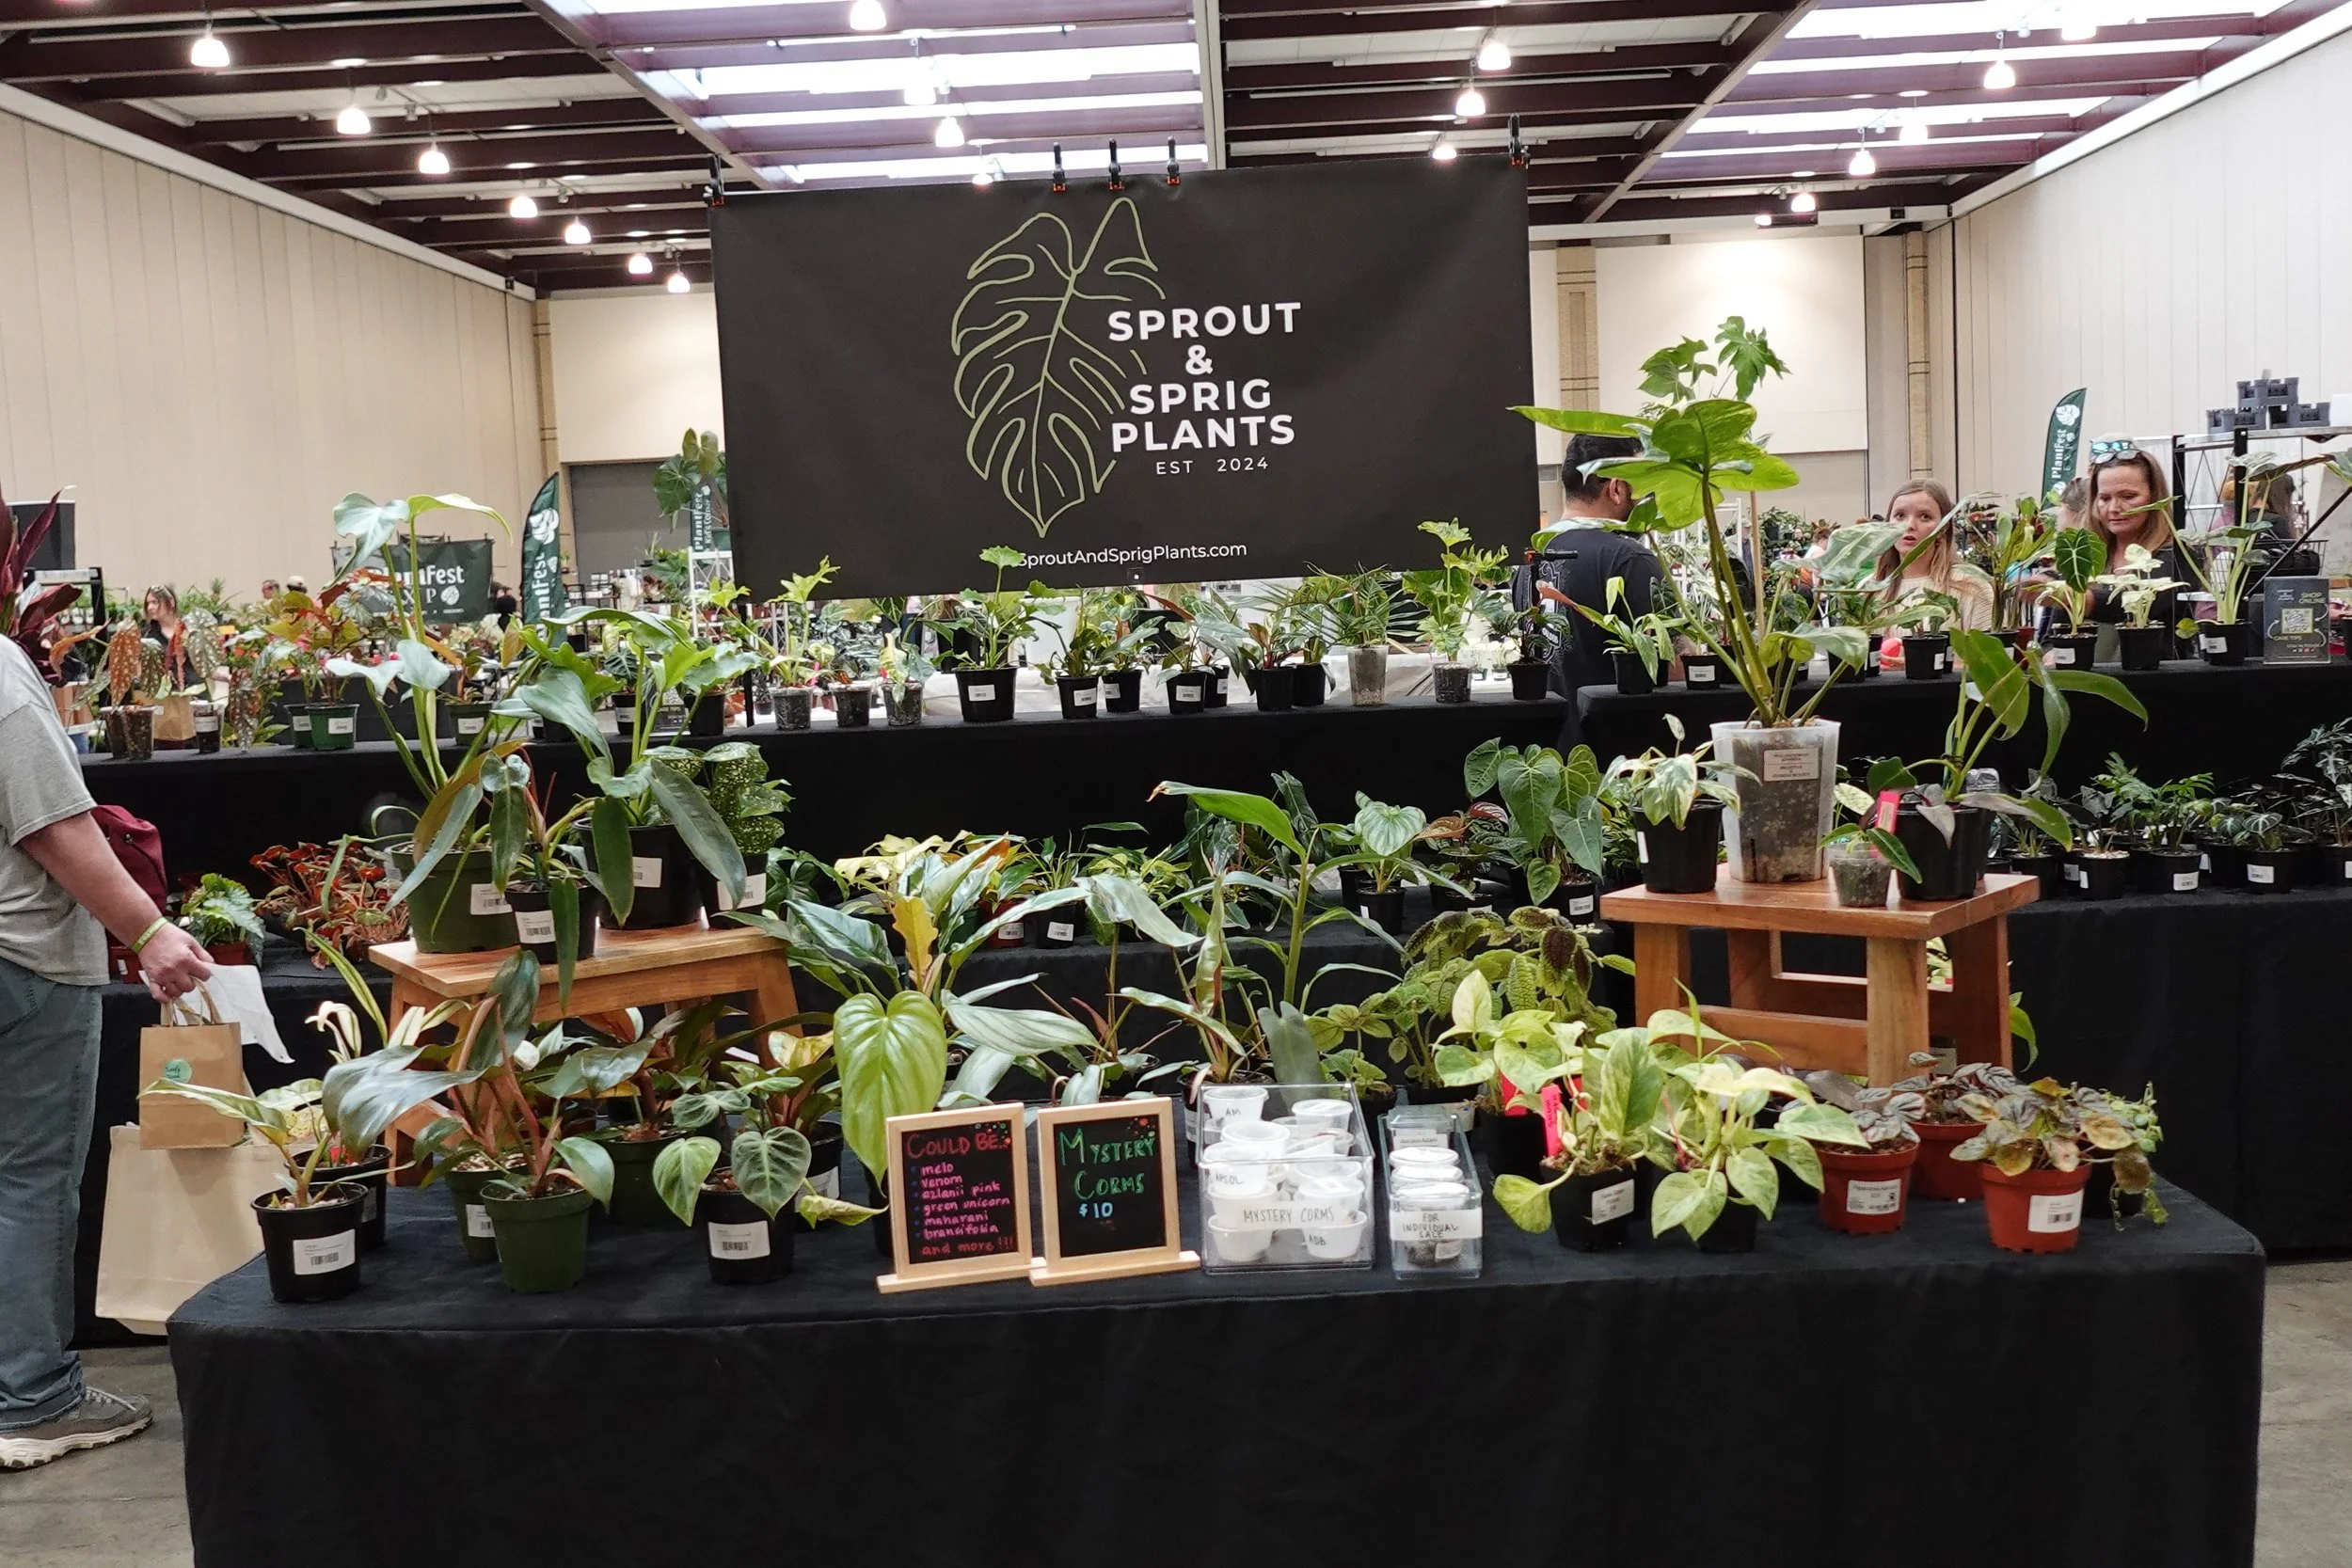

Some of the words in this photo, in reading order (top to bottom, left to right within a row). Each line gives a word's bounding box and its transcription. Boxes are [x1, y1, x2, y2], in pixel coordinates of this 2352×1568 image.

[1107, 302, 1301, 341] SPROUT
[1185, 344, 1214, 375] &
[1130, 378, 1271, 415] SPRIG
[1111, 415, 1295, 452] PLANTS
[1156, 460, 1194, 475] EST
[1216, 457, 1269, 473] 2024
[1019, 544, 1248, 568] SproutAndSprigPlants.com
[907, 1133, 971, 1159] COULD
[921, 1162, 954, 1176] melo
[921, 1175, 962, 1189] venom
[971, 1180, 1001, 1196] pink
[923, 1201, 959, 1216] green
[962, 1196, 1010, 1210] unicorn
[1243, 1209, 1293, 1224] MYSTERY
[1300, 1206, 1334, 1223] CORMS
[925, 1210, 989, 1226] maharani
[1422, 1213, 1439, 1222] FOR
[922, 1243, 950, 1256] and
[958, 1242, 994, 1252] more
